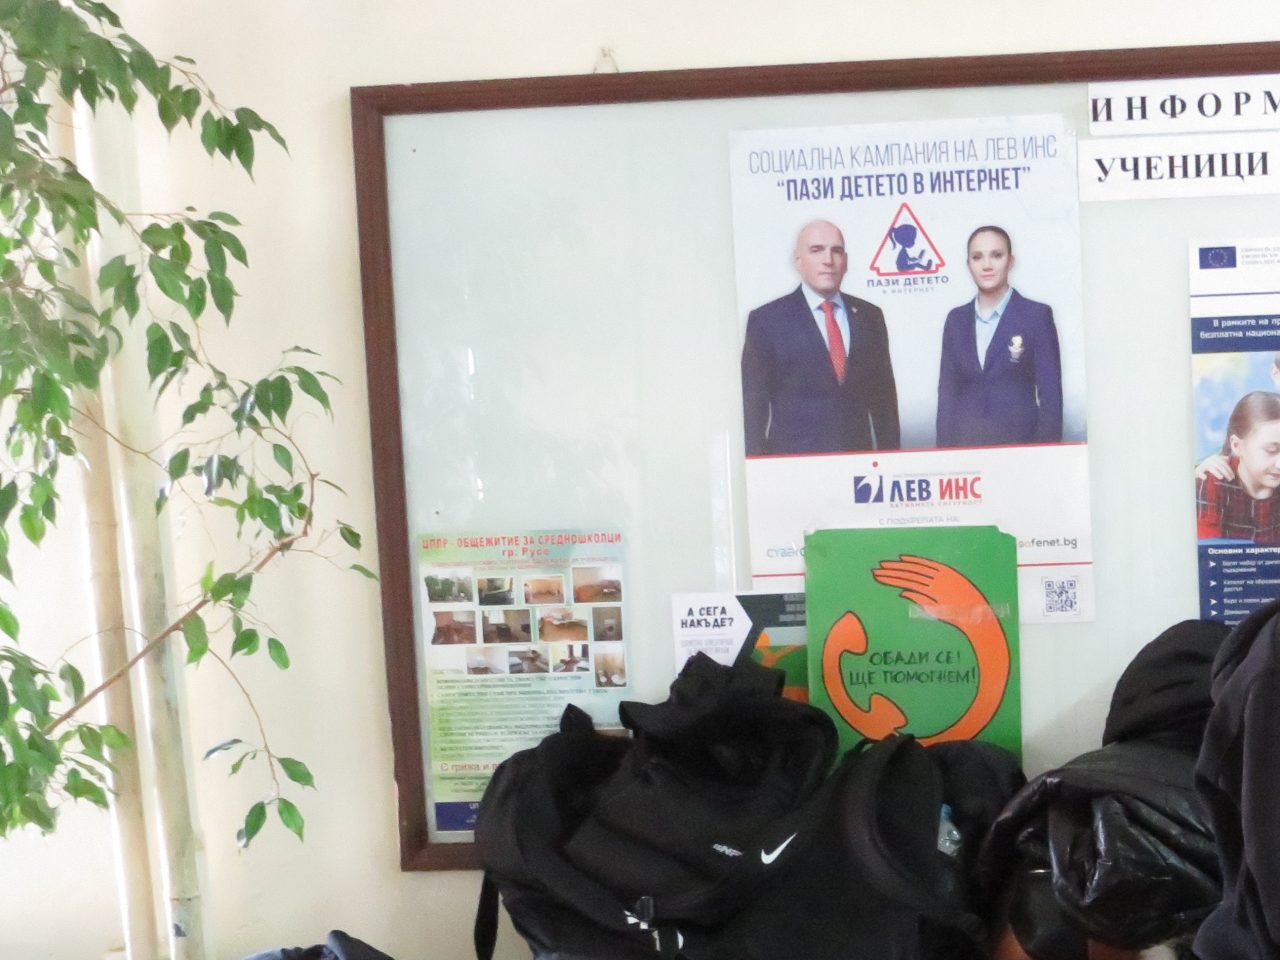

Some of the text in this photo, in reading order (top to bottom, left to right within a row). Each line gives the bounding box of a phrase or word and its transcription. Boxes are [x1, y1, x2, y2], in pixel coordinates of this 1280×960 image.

[749, 134, 1057, 175] СОЦИАЛНА КАМПАНИЯ НА ЛЕВ ИНС
[1094, 151, 1269, 183] УЧЕНИЦИ
[776, 166, 1031, 202] “ПАЗИ ДЕТЕТО В ИНТЕРНЕТ”
[867, 275, 950, 288] ПАЗИ ДЕТЕТО
[1213, 319, 1219, 327] В
[1221, 319, 1256, 328] рамките
[1200, 330, 1243, 339] безплатна
[890, 476, 982, 502] ЛЕВ ИНС
[887, 515, 944, 525] ПОДКРЕПАТА
[457, 535, 520, 549] ОБЩЕЖИТИЕ
[523, 535, 535, 546] ЗА
[538, 533, 622, 546] СРЕДНОШКОЛЦИ
[521, 547, 550, 558] Русе
[1208, 547, 1243, 555] Основни
[687, 606, 727, 617] А СЕГА
[680, 618, 734, 629] НАКЪДЕ?
[869, 650, 961, 667] ОБАДИ СЕ!
[849, 668, 976, 688] ЩЕ ПОМОГНЕМ!
